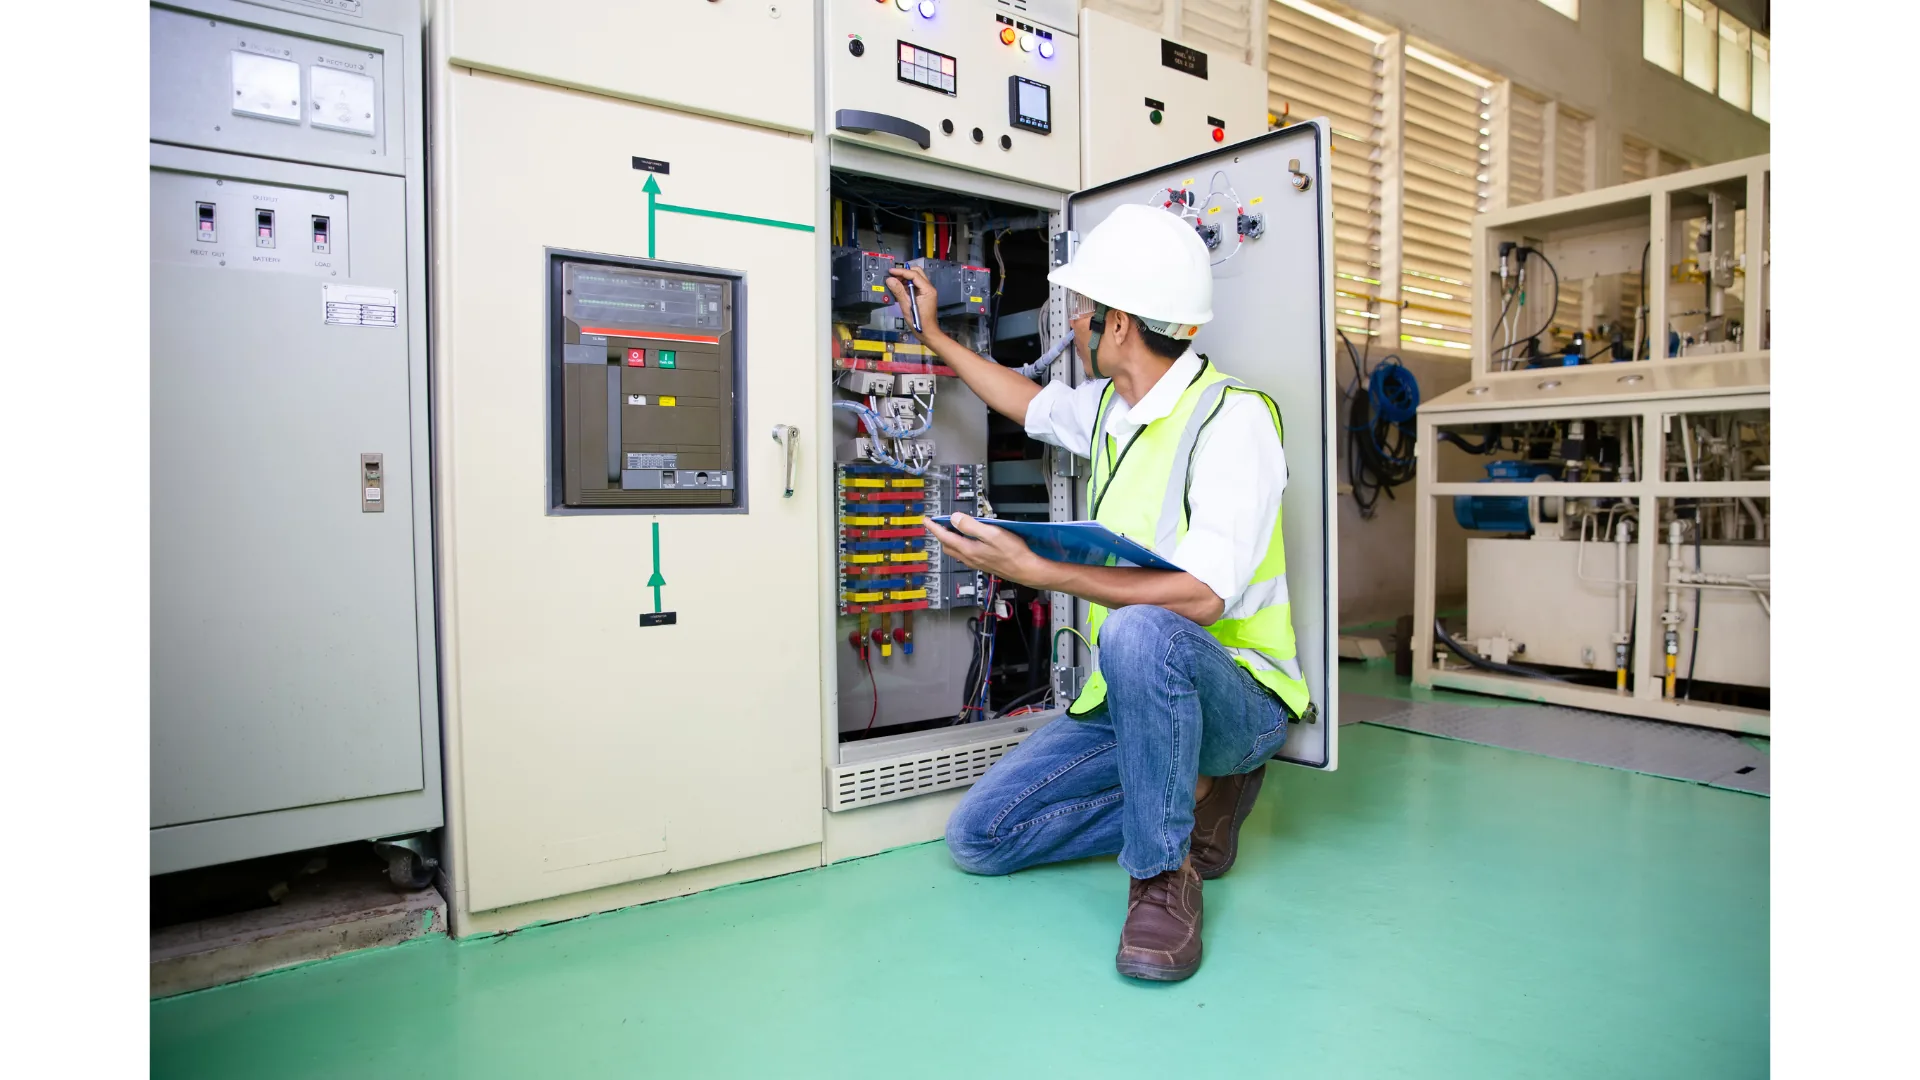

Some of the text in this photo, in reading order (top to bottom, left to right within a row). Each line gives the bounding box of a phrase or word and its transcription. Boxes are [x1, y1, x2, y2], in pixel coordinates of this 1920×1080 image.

[1003, 16, 1008, 24] R
[252, 195, 279, 203] OUTPUT
[252, 255, 281, 263] BATTERY
